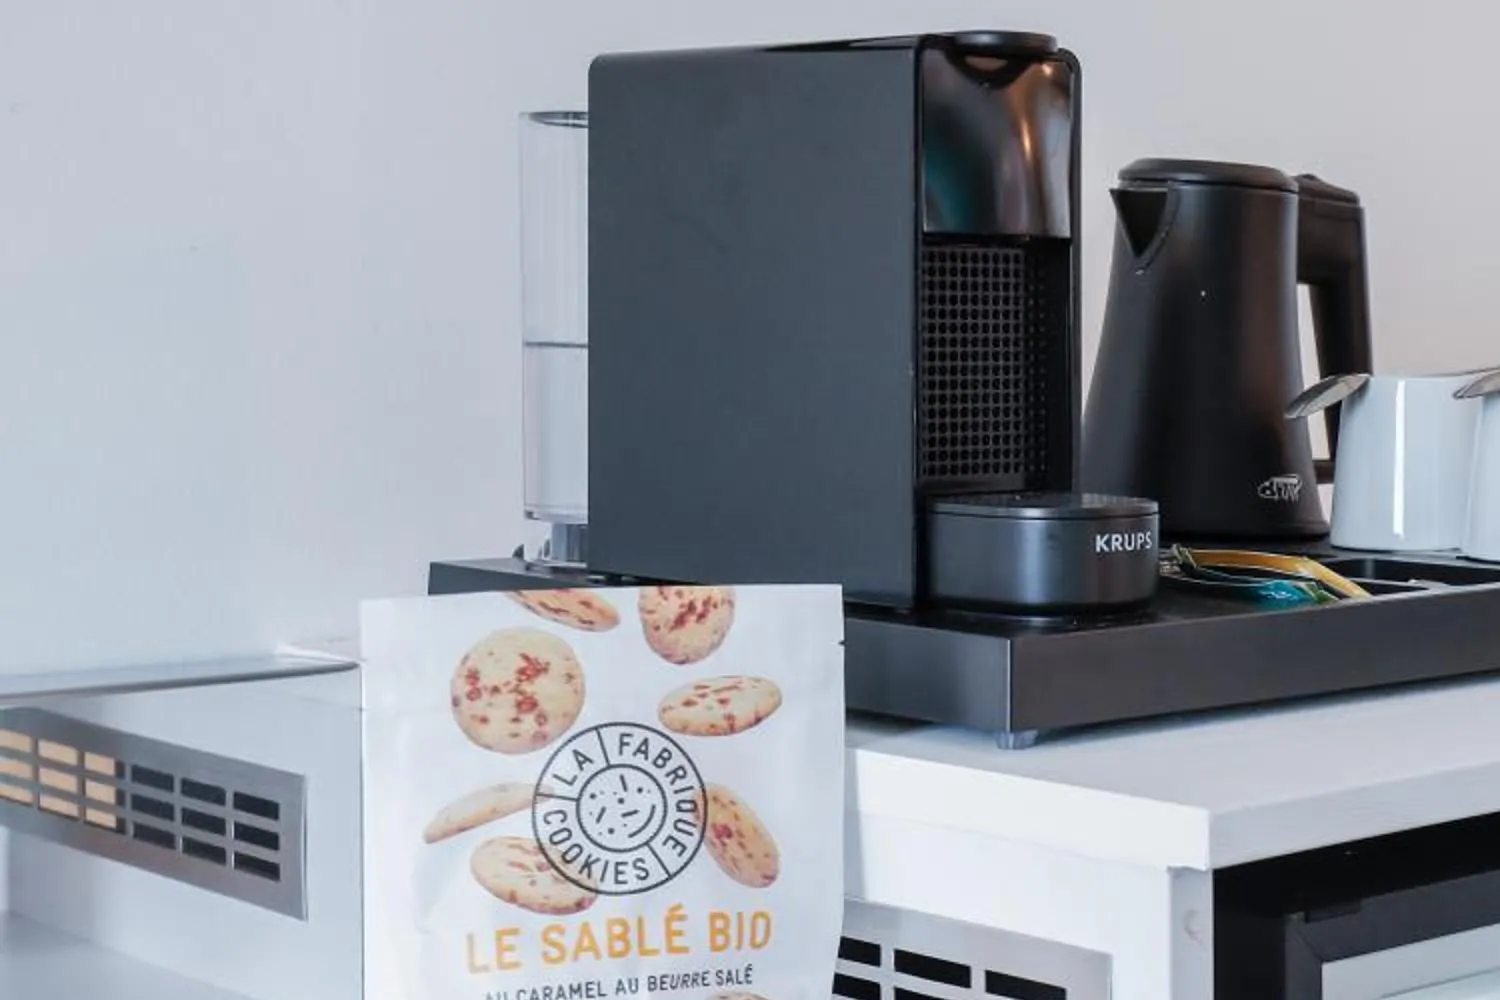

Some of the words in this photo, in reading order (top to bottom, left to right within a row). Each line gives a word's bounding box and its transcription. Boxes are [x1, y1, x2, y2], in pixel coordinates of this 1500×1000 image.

[1095, 531, 1153, 554] KRUPS
[553, 747, 592, 786] LA
[619, 732, 698, 858] FABRIQUE
[542, 808, 651, 886] COOKIES
[465, 927, 523, 974] LE
[541, 903, 690, 964] SABLÉ
[708, 910, 772, 953] BIO
[614, 976, 639, 995] AU
[646, 969, 711, 991] BEURRE
[715, 963, 753, 986] SALÉ
